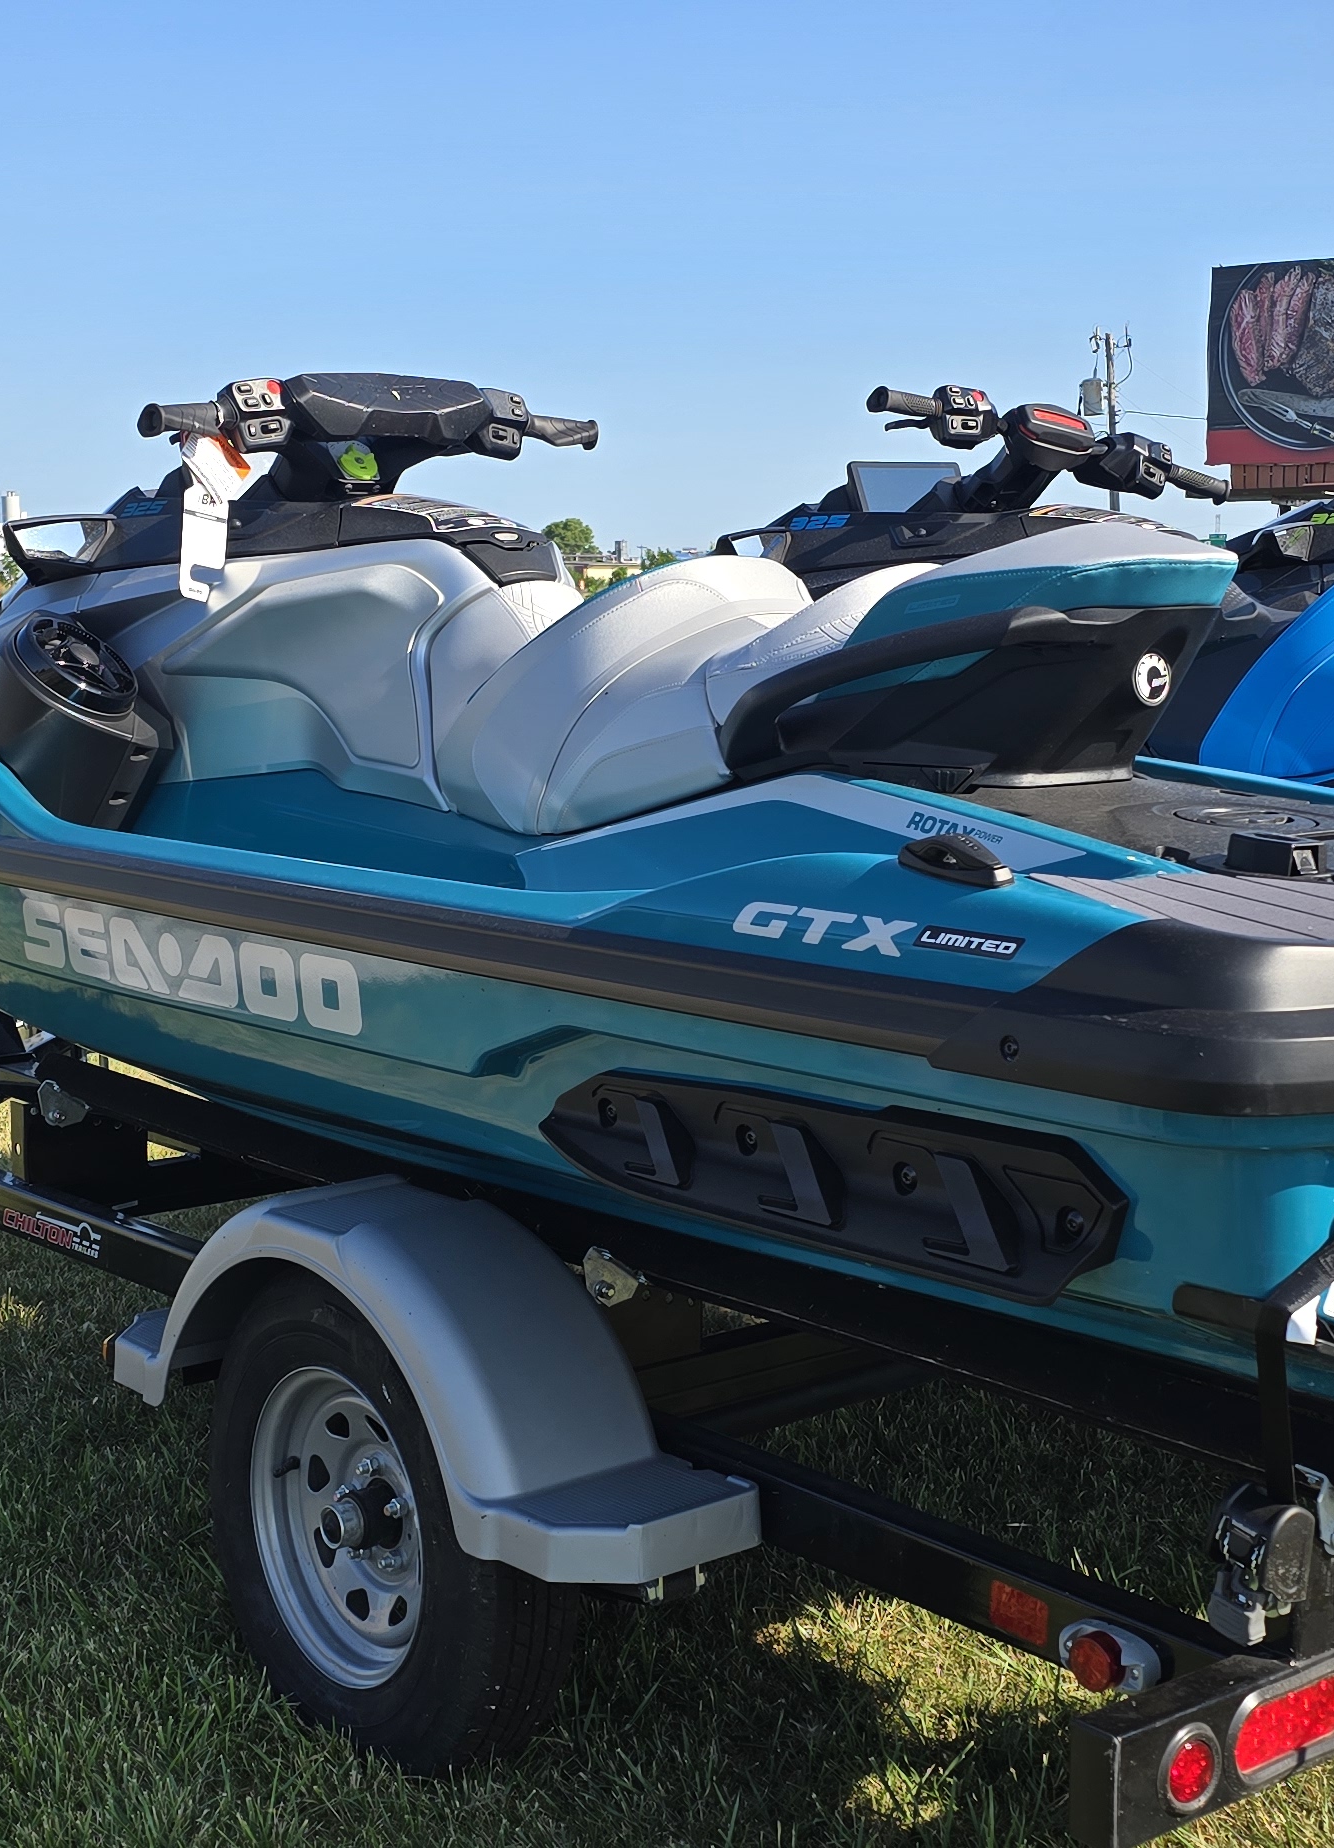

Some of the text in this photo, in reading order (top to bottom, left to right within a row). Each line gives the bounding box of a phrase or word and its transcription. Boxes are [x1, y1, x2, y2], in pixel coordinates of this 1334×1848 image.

[120, 500, 168, 518] 325
[789, 514, 851, 531] 325
[906, 810, 976, 836] ROTAX
[732, 901, 1017, 958] GTX LIMITED
[3, 1208, 99, 1259] CHILTON TRAILERS
